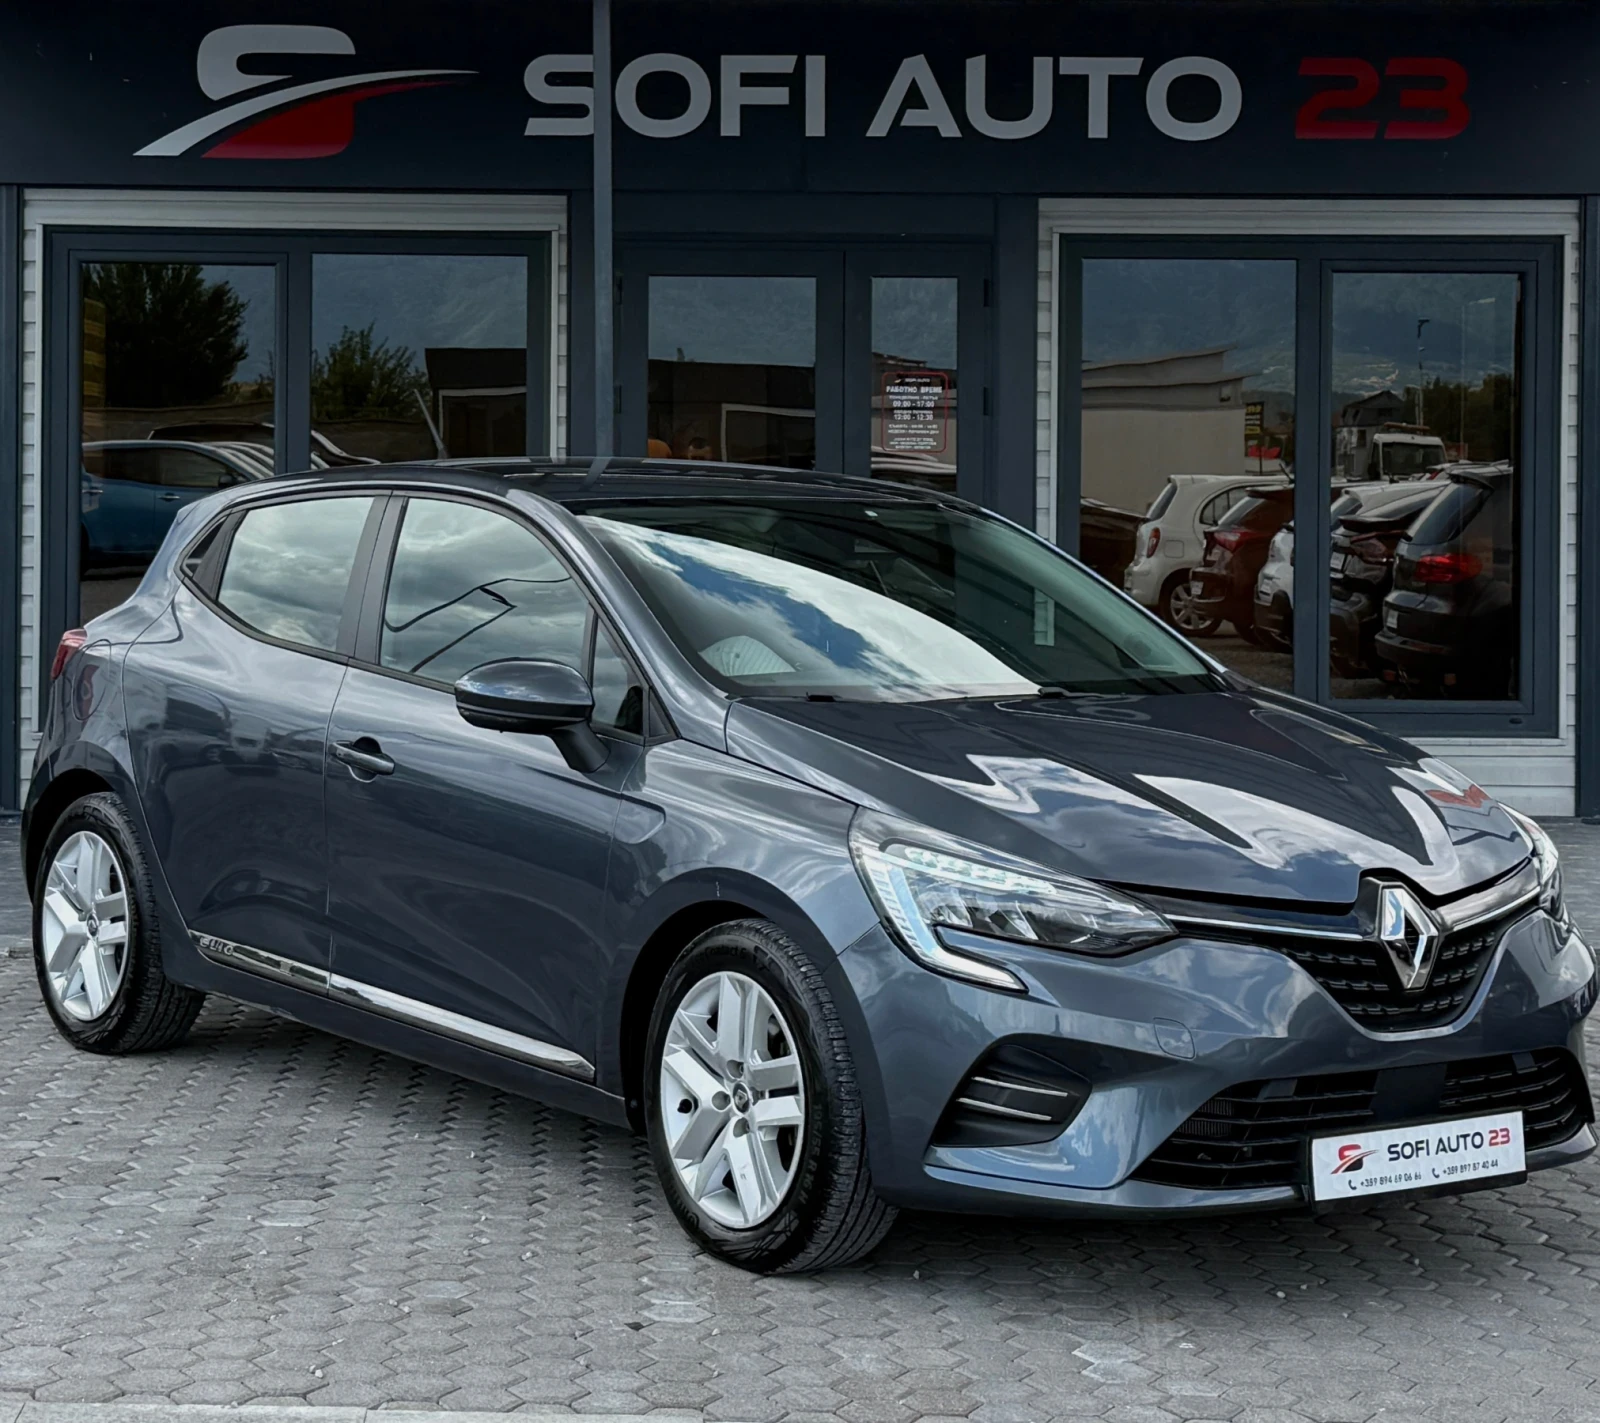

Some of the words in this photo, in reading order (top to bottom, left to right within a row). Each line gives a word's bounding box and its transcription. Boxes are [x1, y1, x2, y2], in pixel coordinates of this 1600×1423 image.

[523, 53, 826, 138] SOFI
[865, 54, 1243, 141] AUTO
[1294, 56, 1471, 140] 23
[920, 386, 943, 394] ВРЕМЕ
[1387, 1139, 1430, 1162] SOFI
[1435, 1131, 1484, 1155] AUTO
[1488, 1127, 1511, 1147] 23
[1443, 1165, 1458, 1175] +359
[1360, 1177, 1378, 1187] +359
